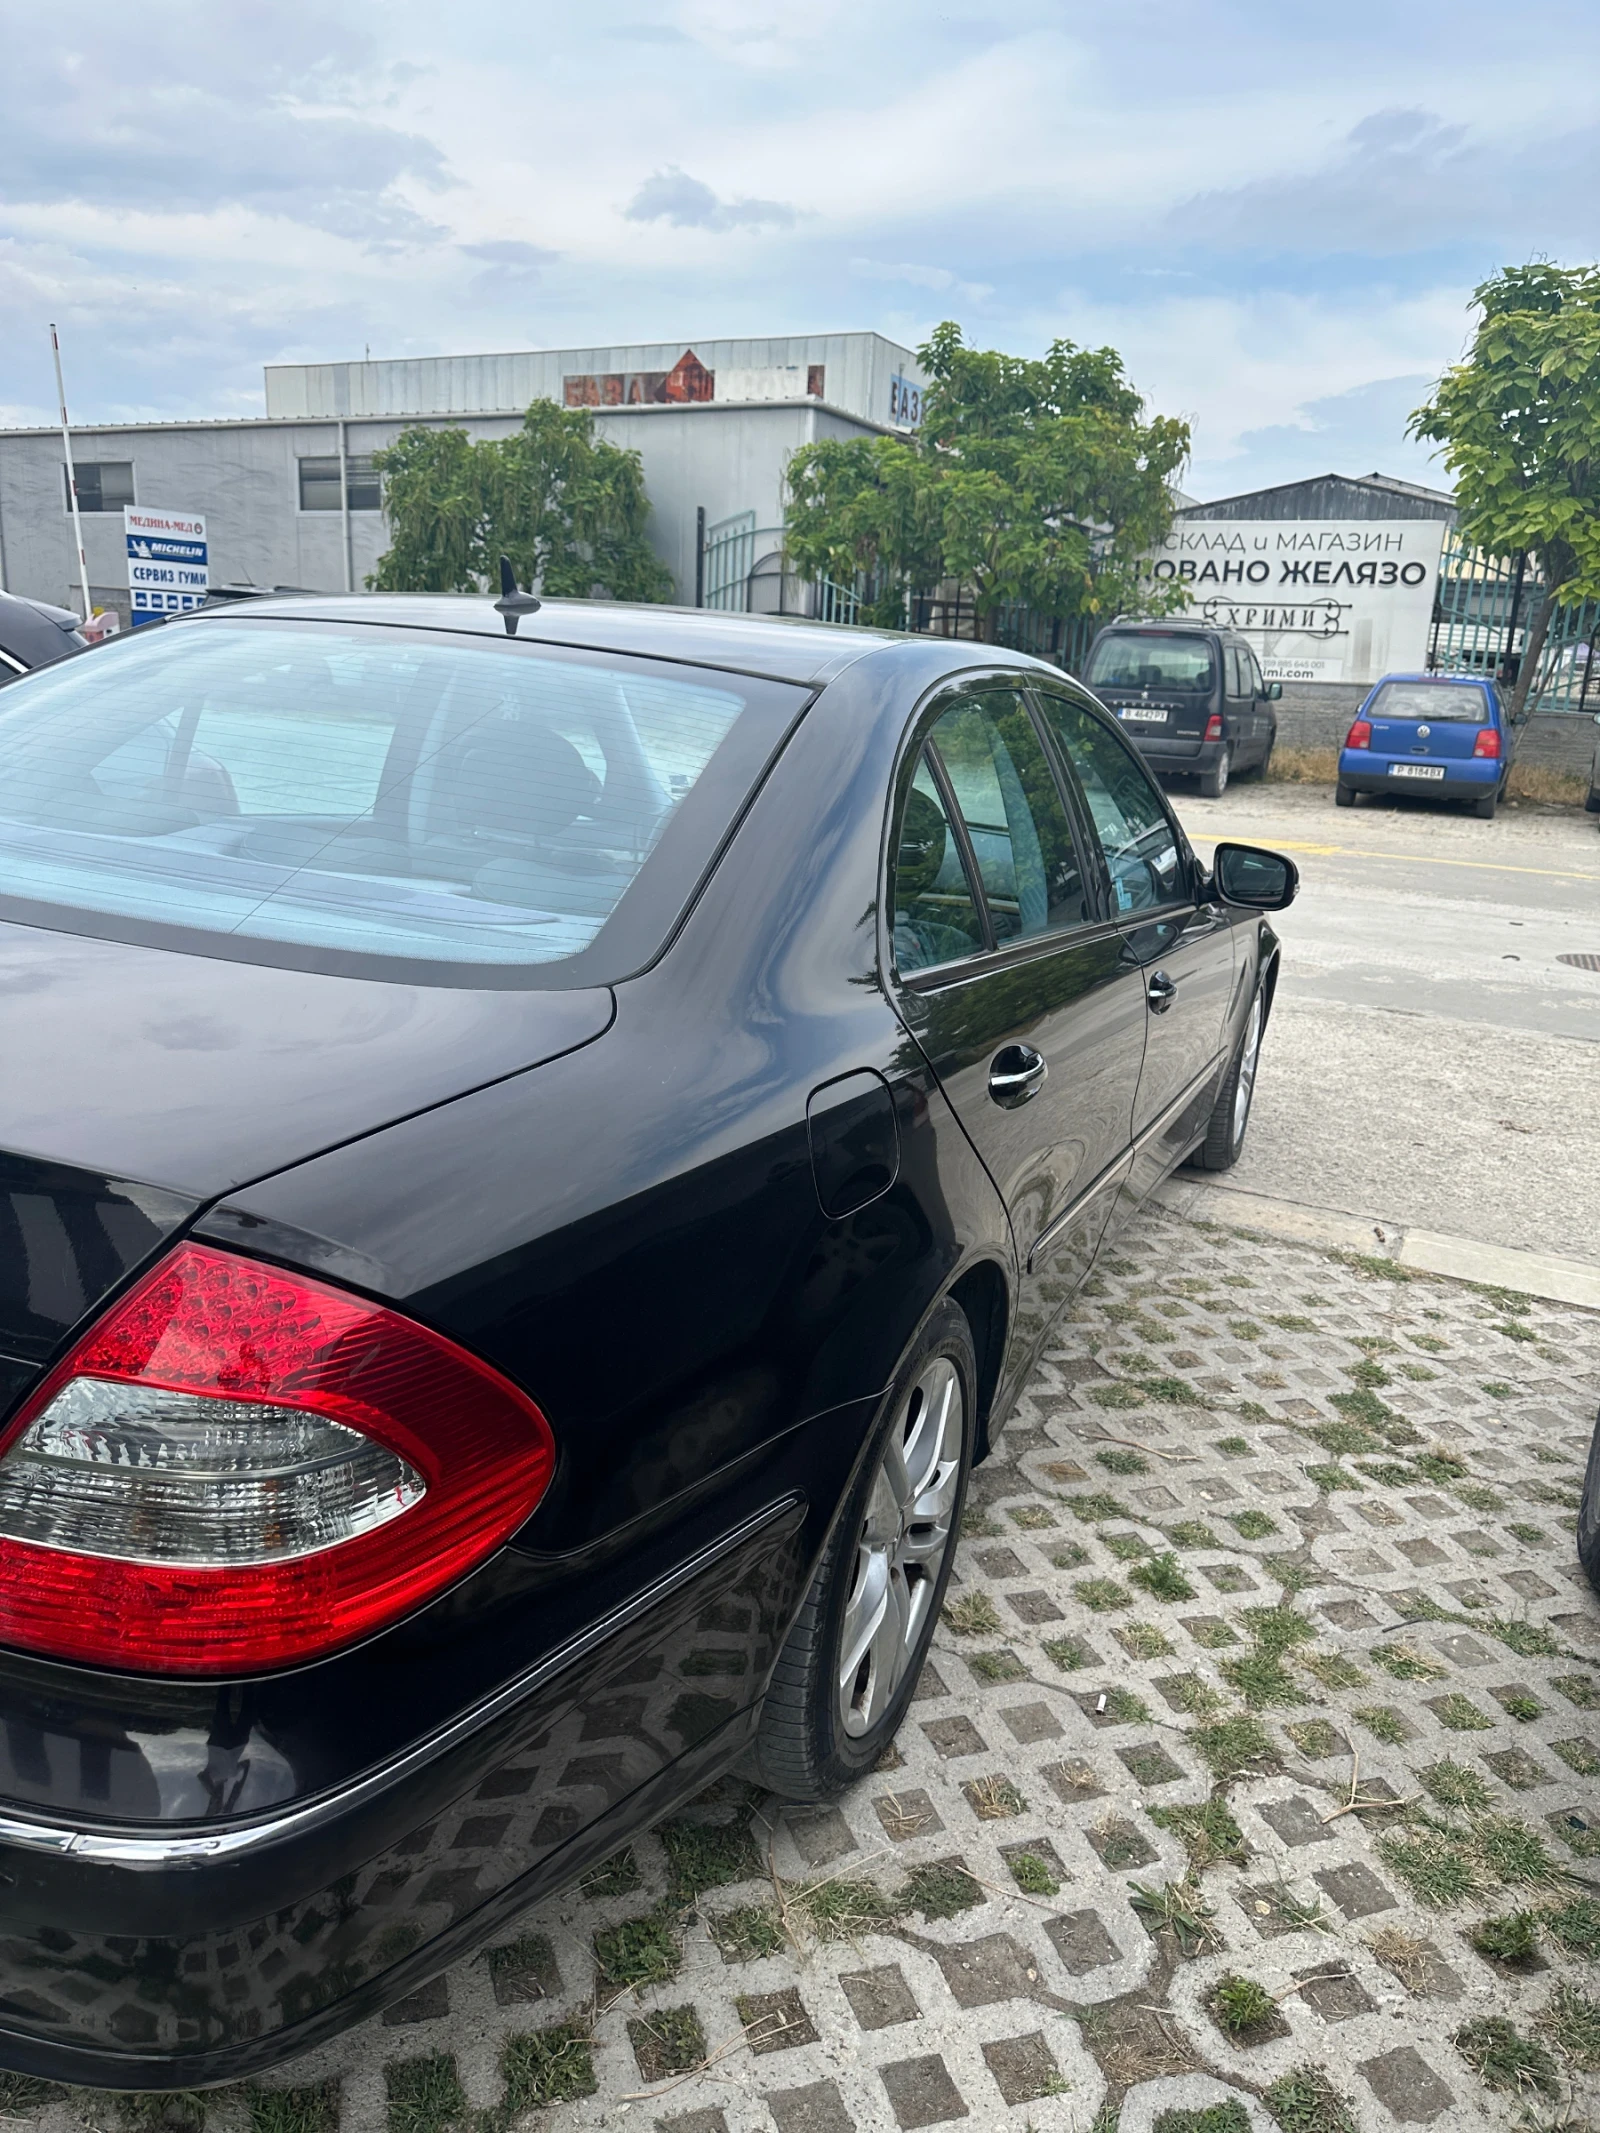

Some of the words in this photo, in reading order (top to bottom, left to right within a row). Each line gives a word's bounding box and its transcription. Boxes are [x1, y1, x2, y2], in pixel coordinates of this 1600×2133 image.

[151, 542, 204, 557] MICHELIN
[1163, 532, 1246, 554] СКЛАД
[1276, 532, 1403, 551] МАГАЗИН
[133, 566, 174, 583] СЕРВИЗ
[178, 570, 207, 586] ГУМИ
[1278, 560, 1427, 586] ЖЕЛЯЗО
[1226, 607, 1315, 629] ХРИМИ
[1260, 667, 1314, 679] imi.com
